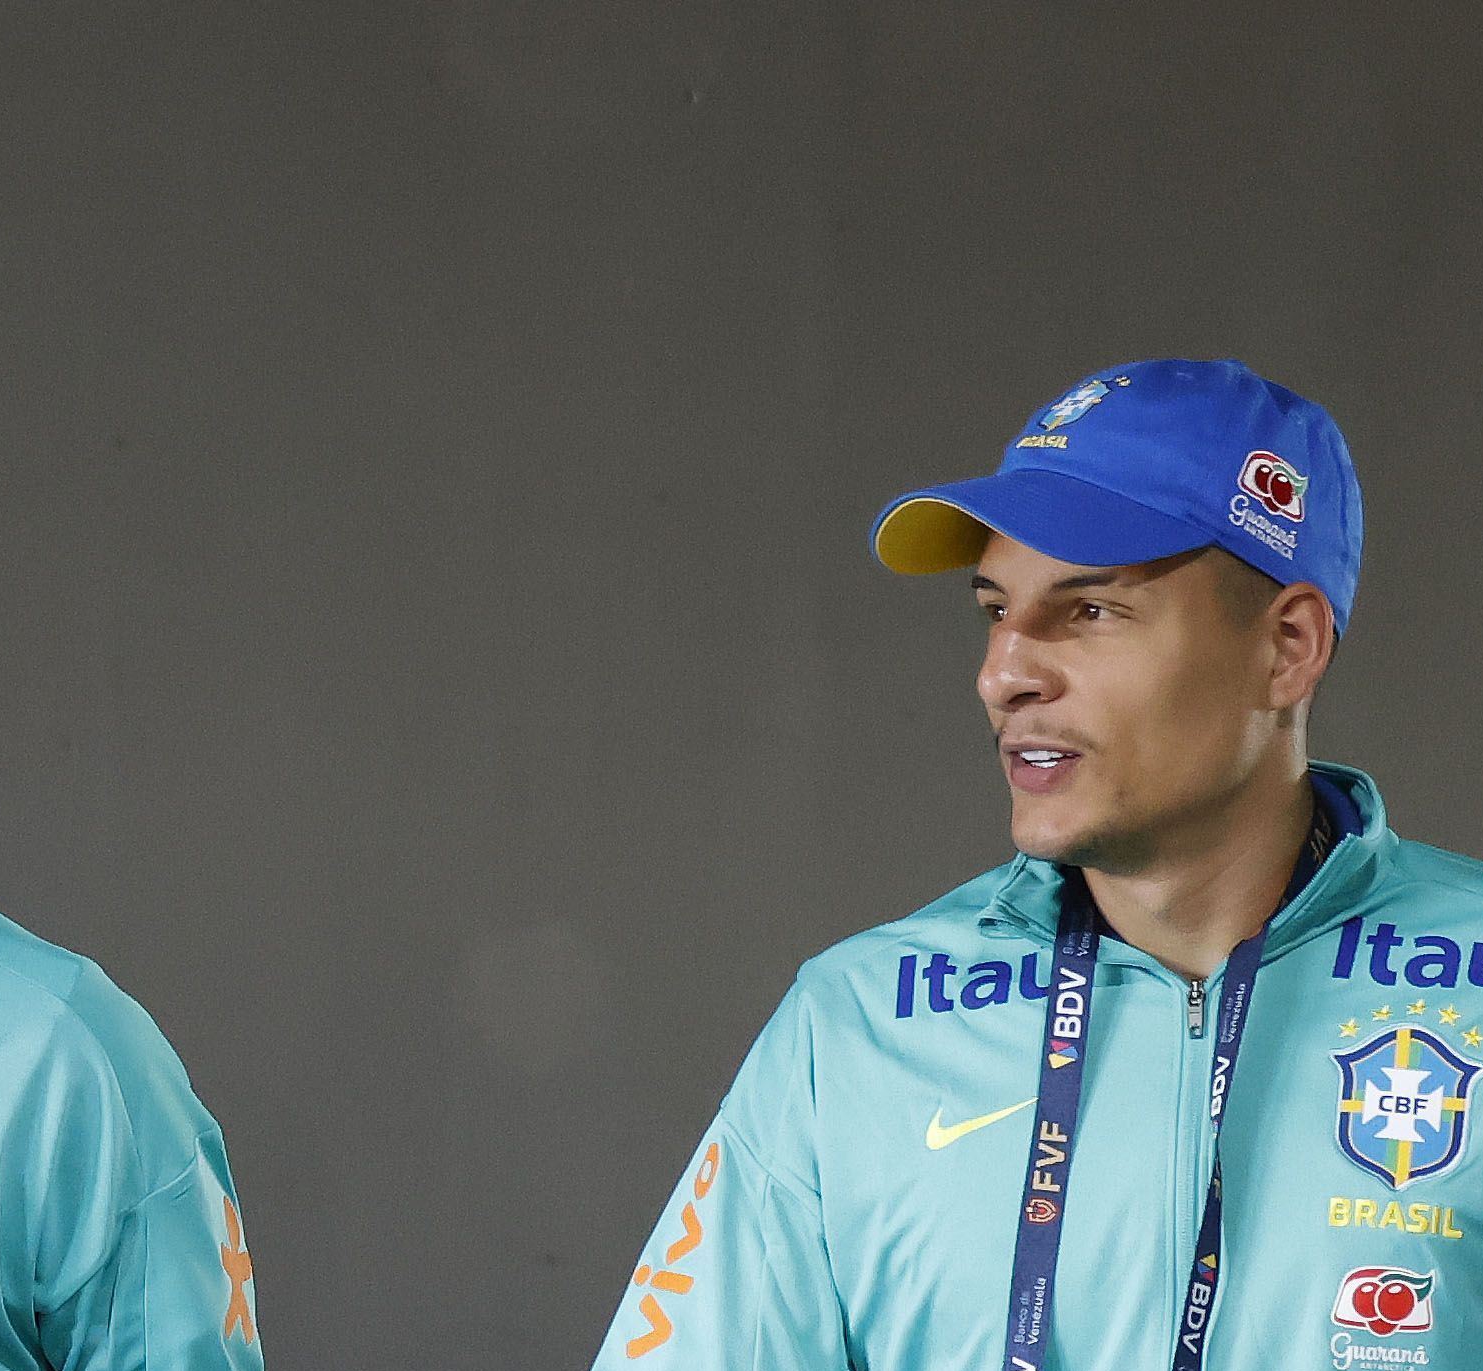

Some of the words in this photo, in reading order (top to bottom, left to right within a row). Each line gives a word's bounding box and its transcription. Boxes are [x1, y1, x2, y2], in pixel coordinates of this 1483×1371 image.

[1053, 967, 1088, 1039] BDV
[1378, 1095, 1429, 1116] CBF
[1031, 1120, 1068, 1192] FVF
[625, 1142, 721, 1359] vivo
[1328, 1197, 1464, 1240] BRASIL
[1027, 1277, 1048, 1346] Venezuela
[1183, 1282, 1211, 1354] BDV
[1330, 1332, 1430, 1371] Guaraná
